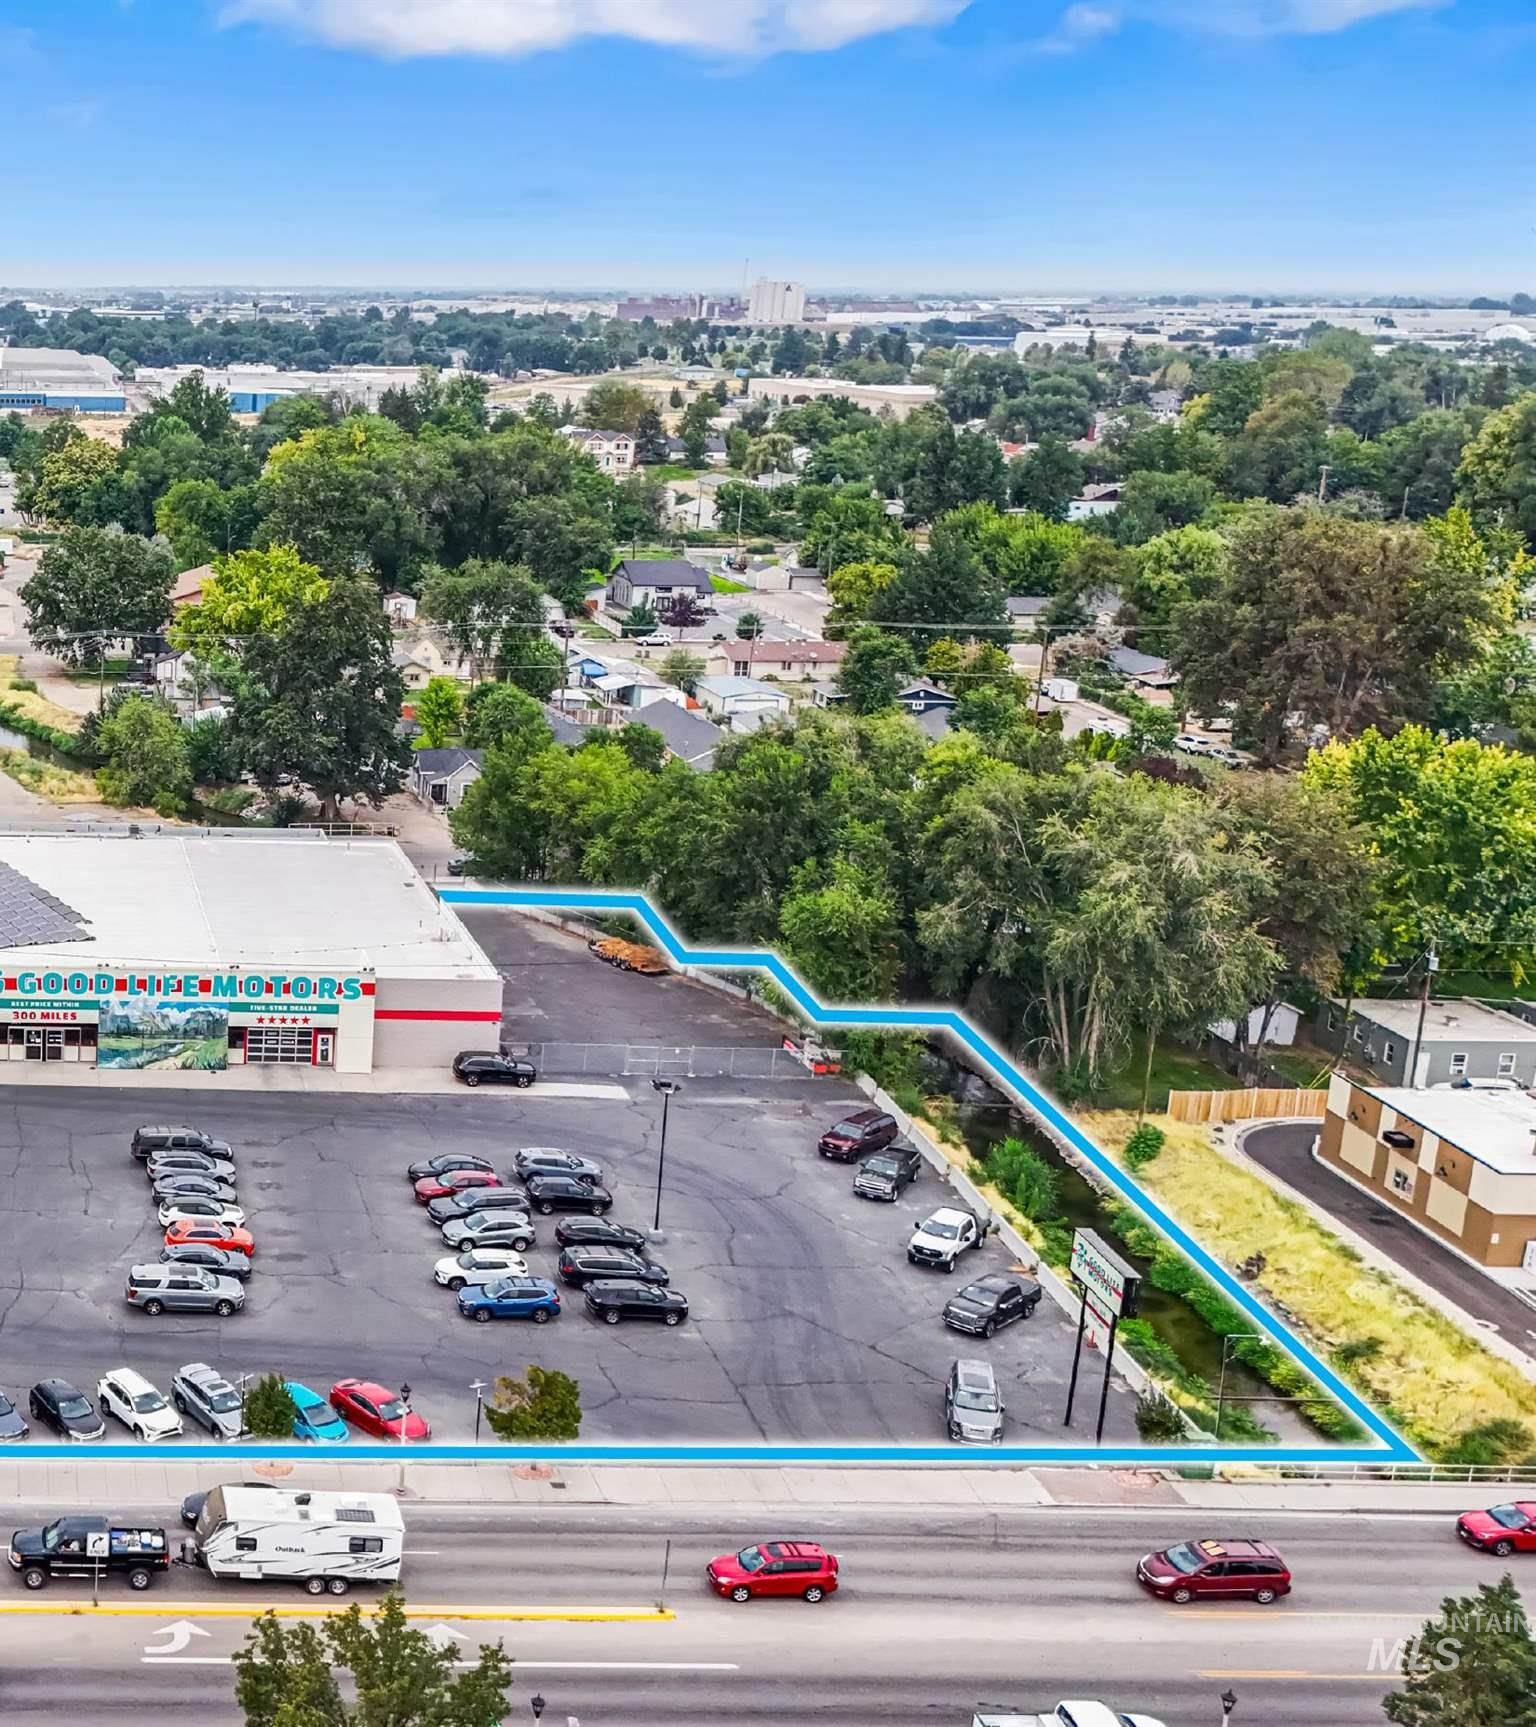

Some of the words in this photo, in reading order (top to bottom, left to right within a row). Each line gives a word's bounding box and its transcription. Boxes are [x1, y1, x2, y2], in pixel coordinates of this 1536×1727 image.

[17, 972, 114, 995] GOOD
[127, 974, 199, 997] LIFE
[212, 975, 361, 1000] MOTORS
[289, 1004, 318, 1012] DEALER
[12, 1011, 36, 1020] 300
[40, 1011, 78, 1021] MILES
[274, 1545, 305, 1553] Outback
